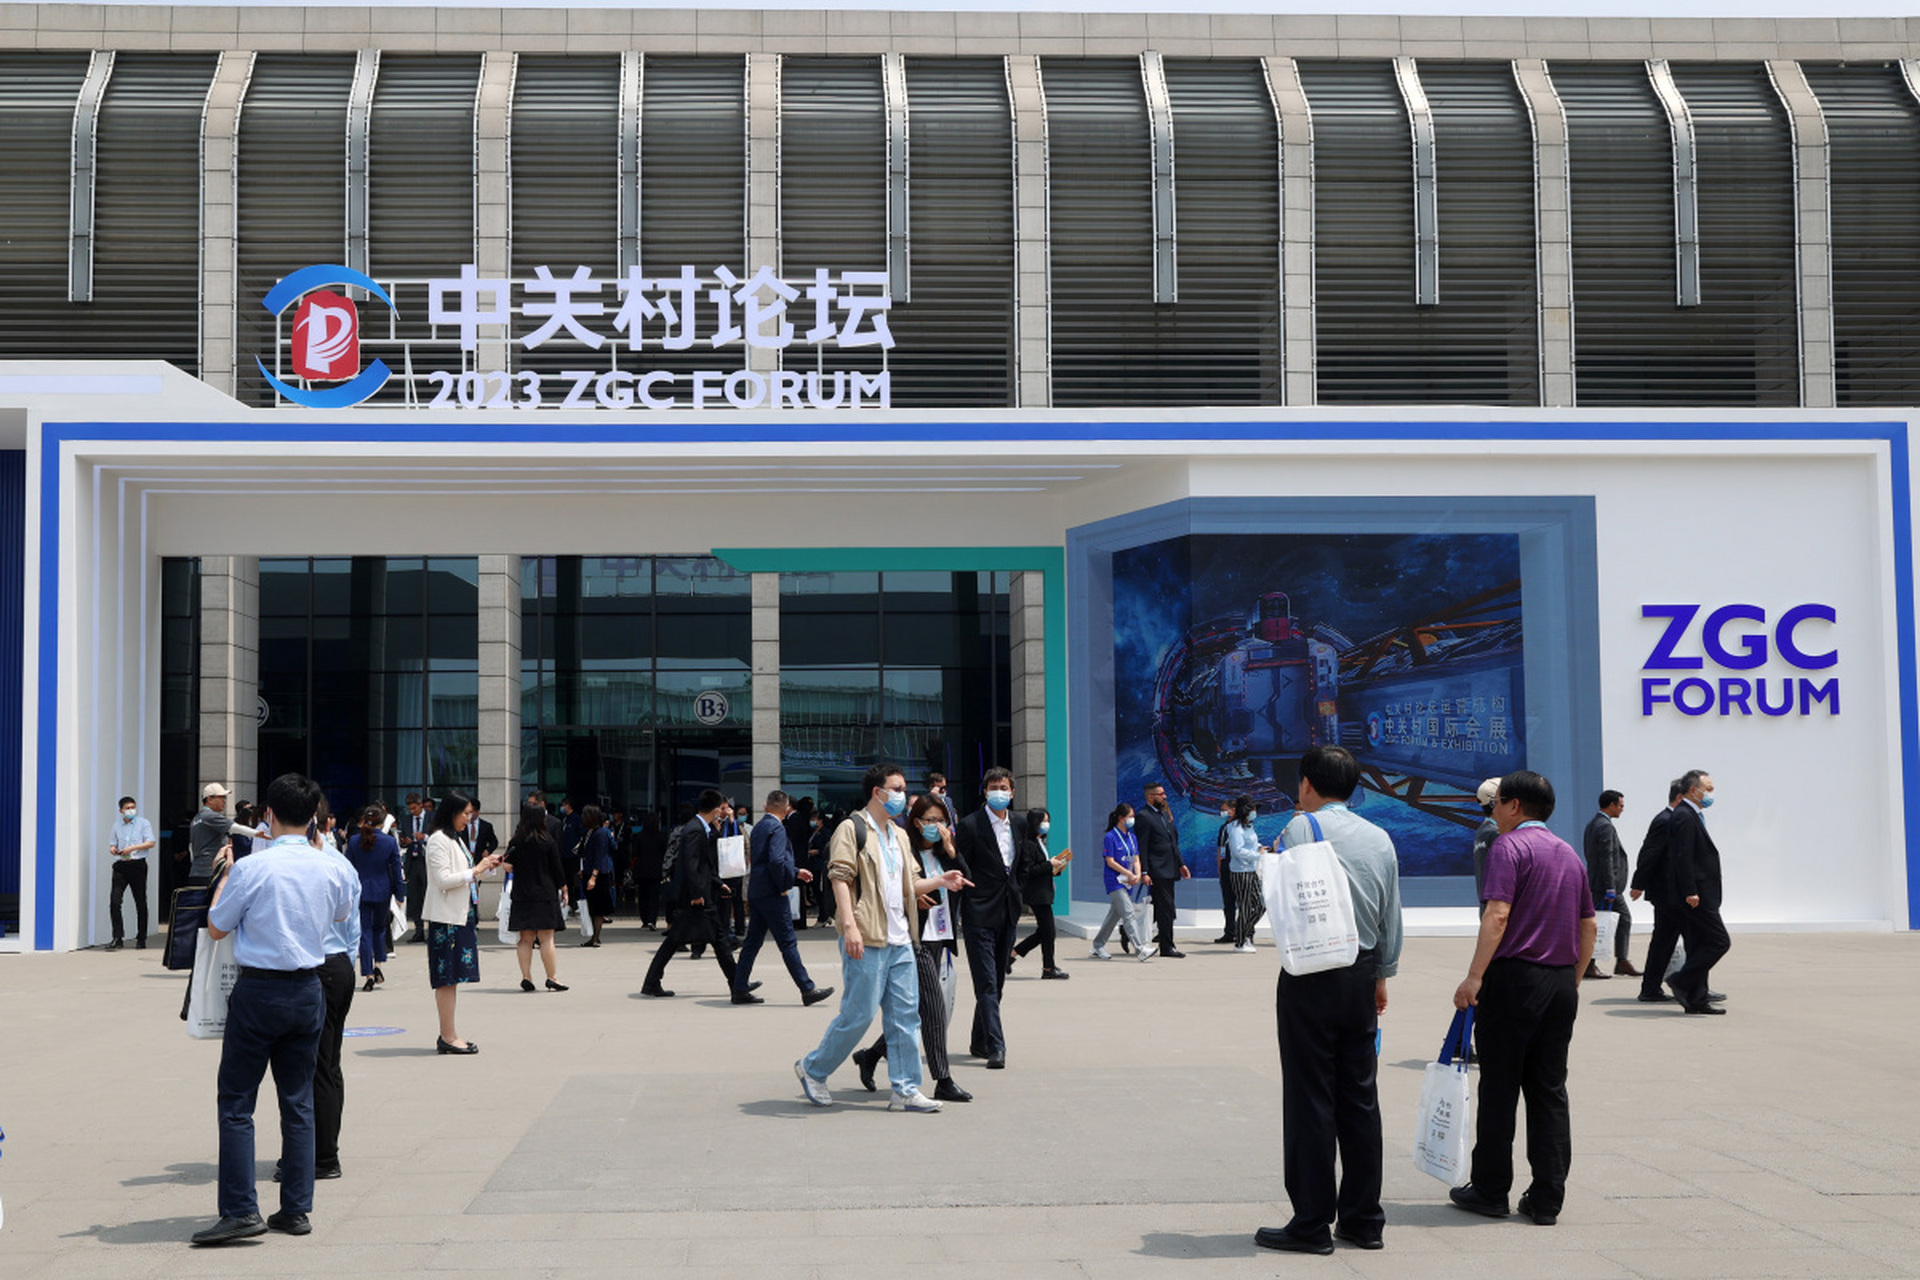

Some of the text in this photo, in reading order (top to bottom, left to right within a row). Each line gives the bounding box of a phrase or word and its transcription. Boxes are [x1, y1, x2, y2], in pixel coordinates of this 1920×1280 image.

[427, 263, 897, 351] 中关村论坛
[427, 371, 891, 409] 2023 ZGC FORUM
[1641, 603, 1838, 671] ZGC
[699, 699, 726, 717] B3
[1641, 677, 1840, 716] FORUM
[1385, 717, 1508, 740] 中关村国际会展
[1441, 739, 1508, 755] EXHIBITION
